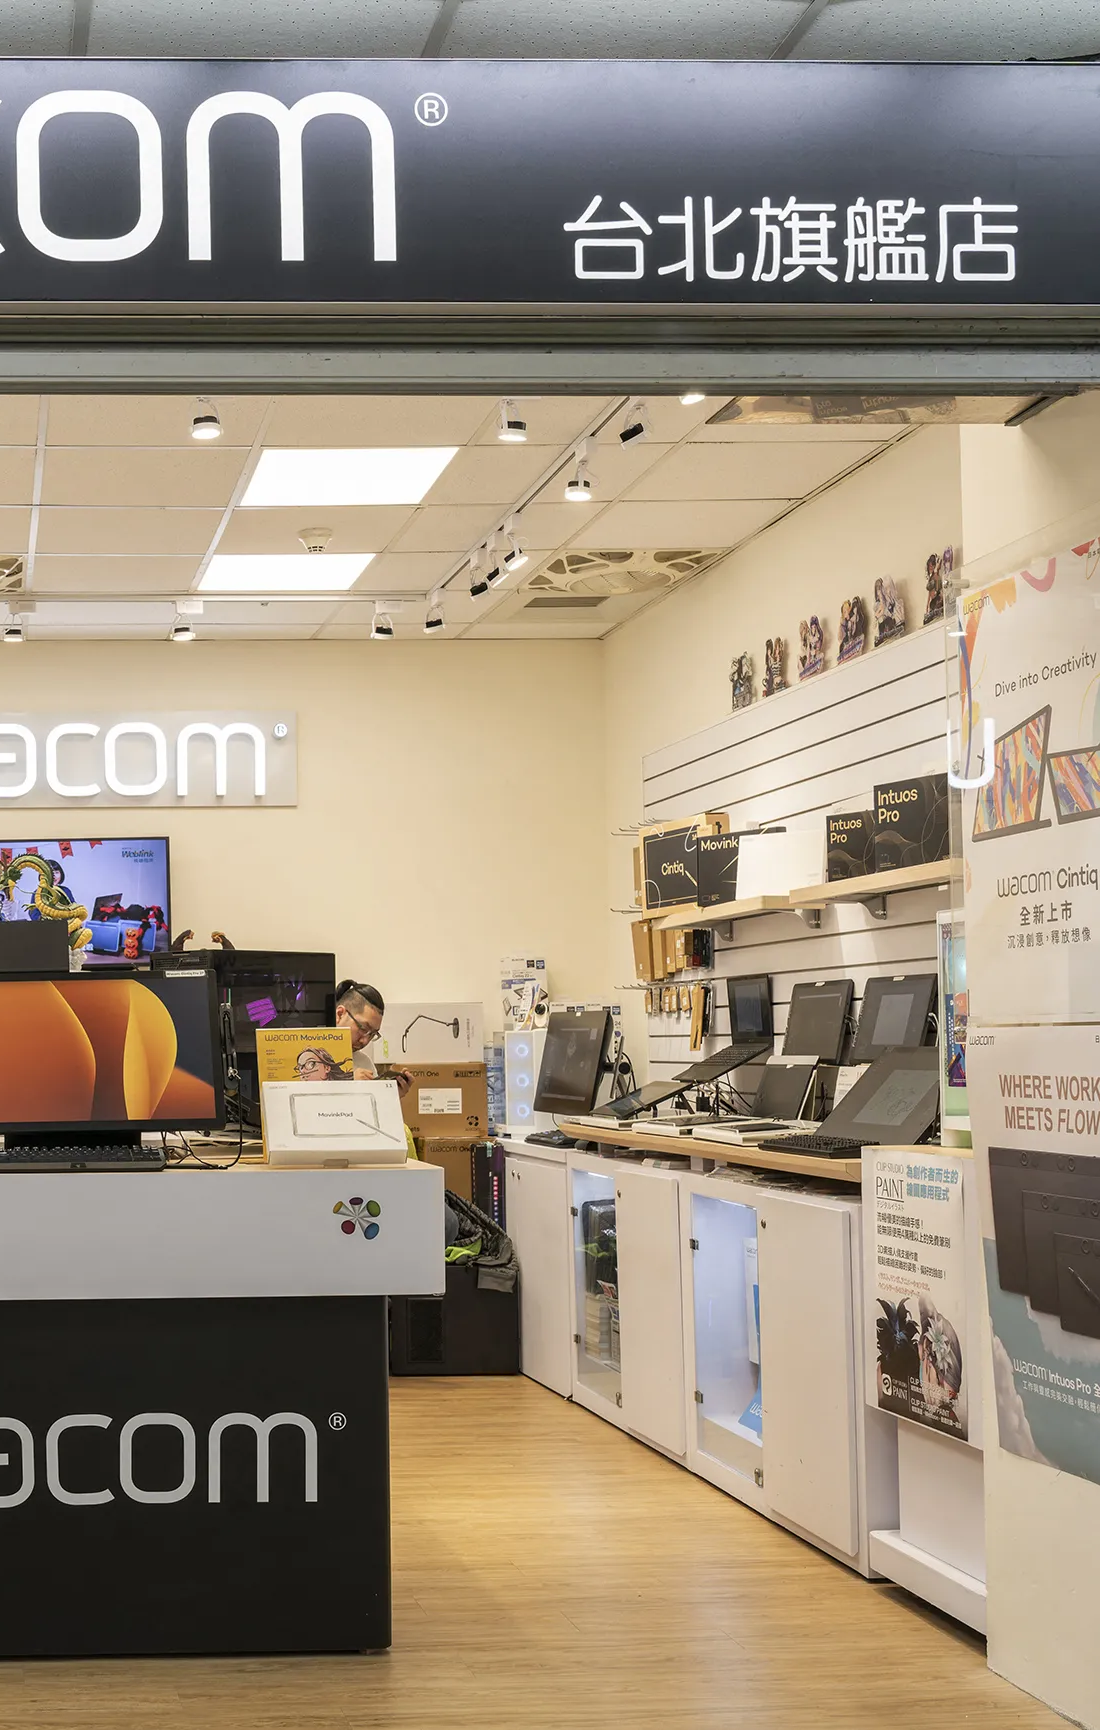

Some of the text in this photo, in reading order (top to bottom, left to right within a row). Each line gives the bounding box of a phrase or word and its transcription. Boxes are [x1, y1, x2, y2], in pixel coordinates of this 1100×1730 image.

[563, 195, 1018, 283] 台北旗艦店
[963, 595, 990, 615] wacom
[994, 652, 1097, 697] Dive into Creativity
[878, 789, 918, 806] Intuos
[830, 819, 862, 831] Intuos
[878, 808, 900, 824] Pro
[701, 836, 739, 851] Movink
[830, 833, 847, 844] Pro
[661, 860, 684, 876] Cintiq
[997, 864, 1099, 898] wacom Cintiq
[1019, 900, 1073, 926] 全新上市
[1007, 926, 1091, 950] 沉浸創意，釋放想像
[300, 1033, 343, 1041] MovinkPad
[969, 1035, 995, 1046] wacom
[999, 1074, 1100, 1102] WHERE WORK
[1004, 1105, 1100, 1136] MEETS FLOW
[906, 1165, 959, 1185] 為創作者而生的
[876, 1176, 904, 1199] PAINT
[1013, 1358, 1047, 1381] wacom
[1049, 1369, 1075, 1390] Intuos
[1076, 1378, 1091, 1394] Pro
[893, 1386, 908, 1400] PAINT
